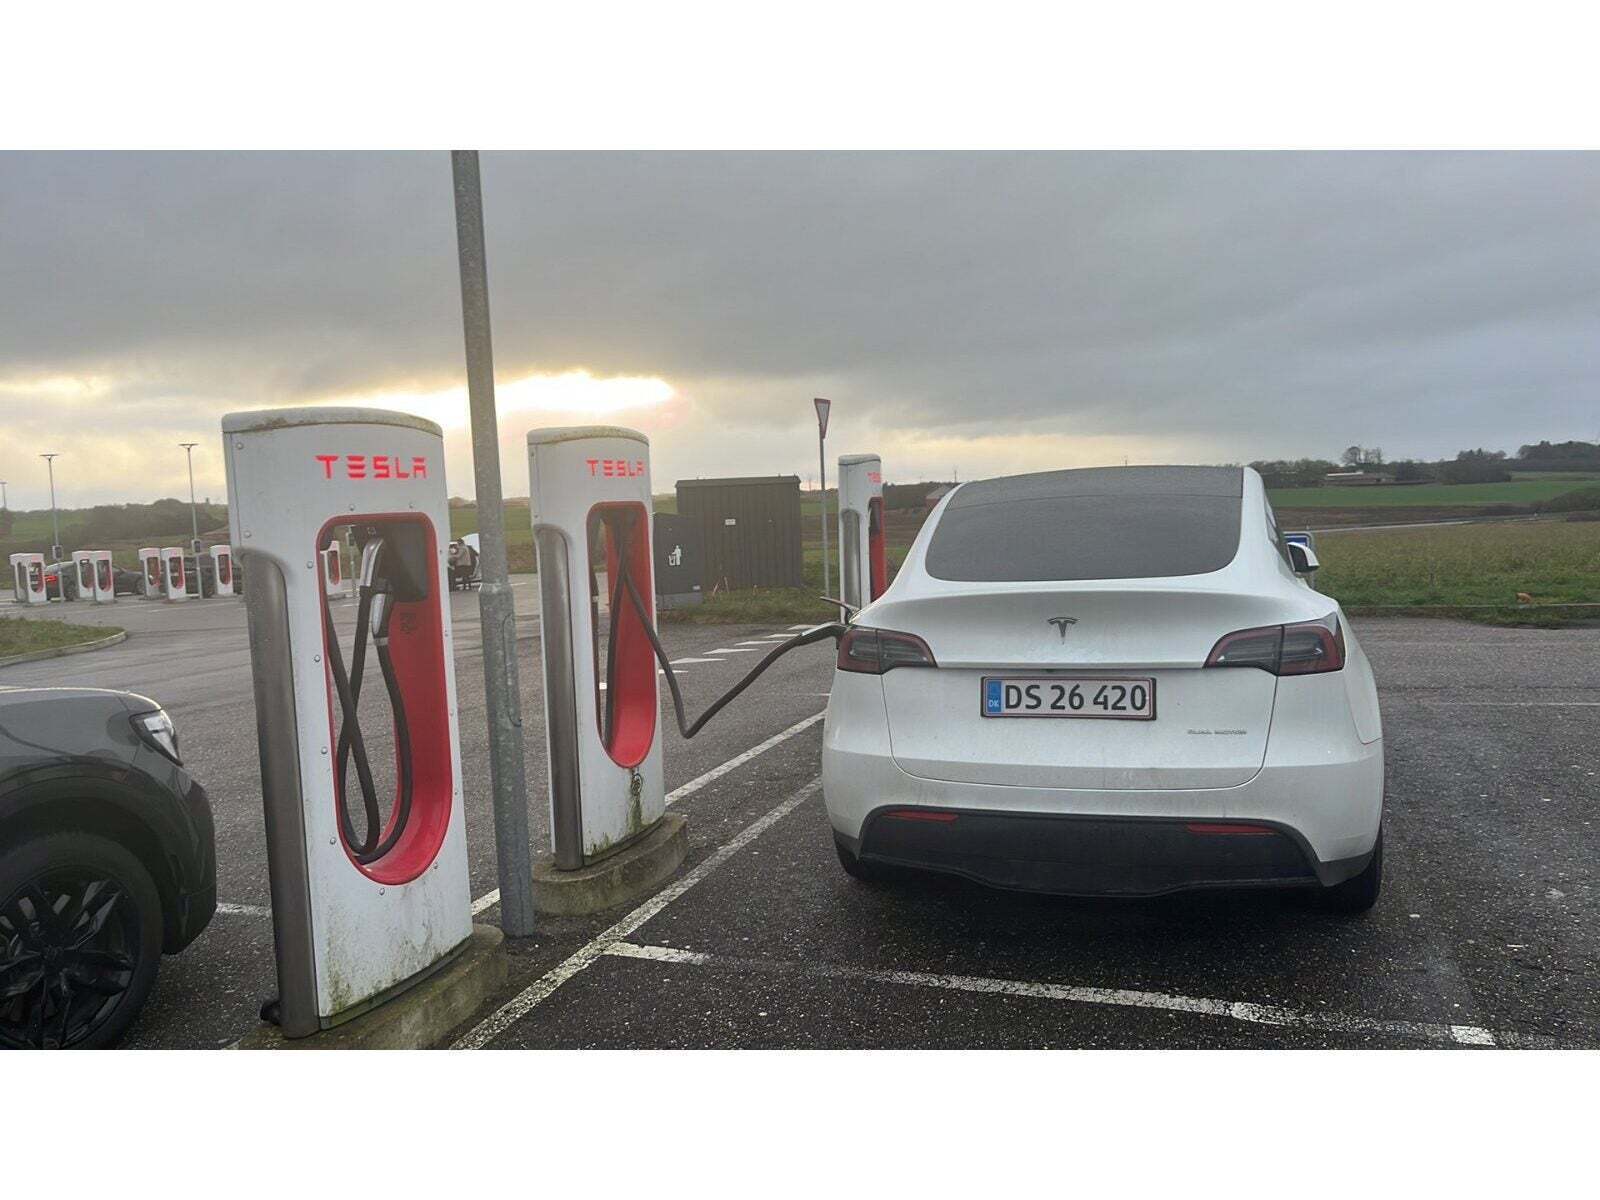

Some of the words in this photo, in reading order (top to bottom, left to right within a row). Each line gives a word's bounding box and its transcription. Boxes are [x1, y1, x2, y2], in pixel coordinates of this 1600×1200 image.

[315, 455, 427, 479] TESLA
[586, 459, 645, 477] TESLA
[1005, 684, 1042, 710] DS
[1050, 683, 1085, 711] 26
[1092, 684, 1148, 712] 420
